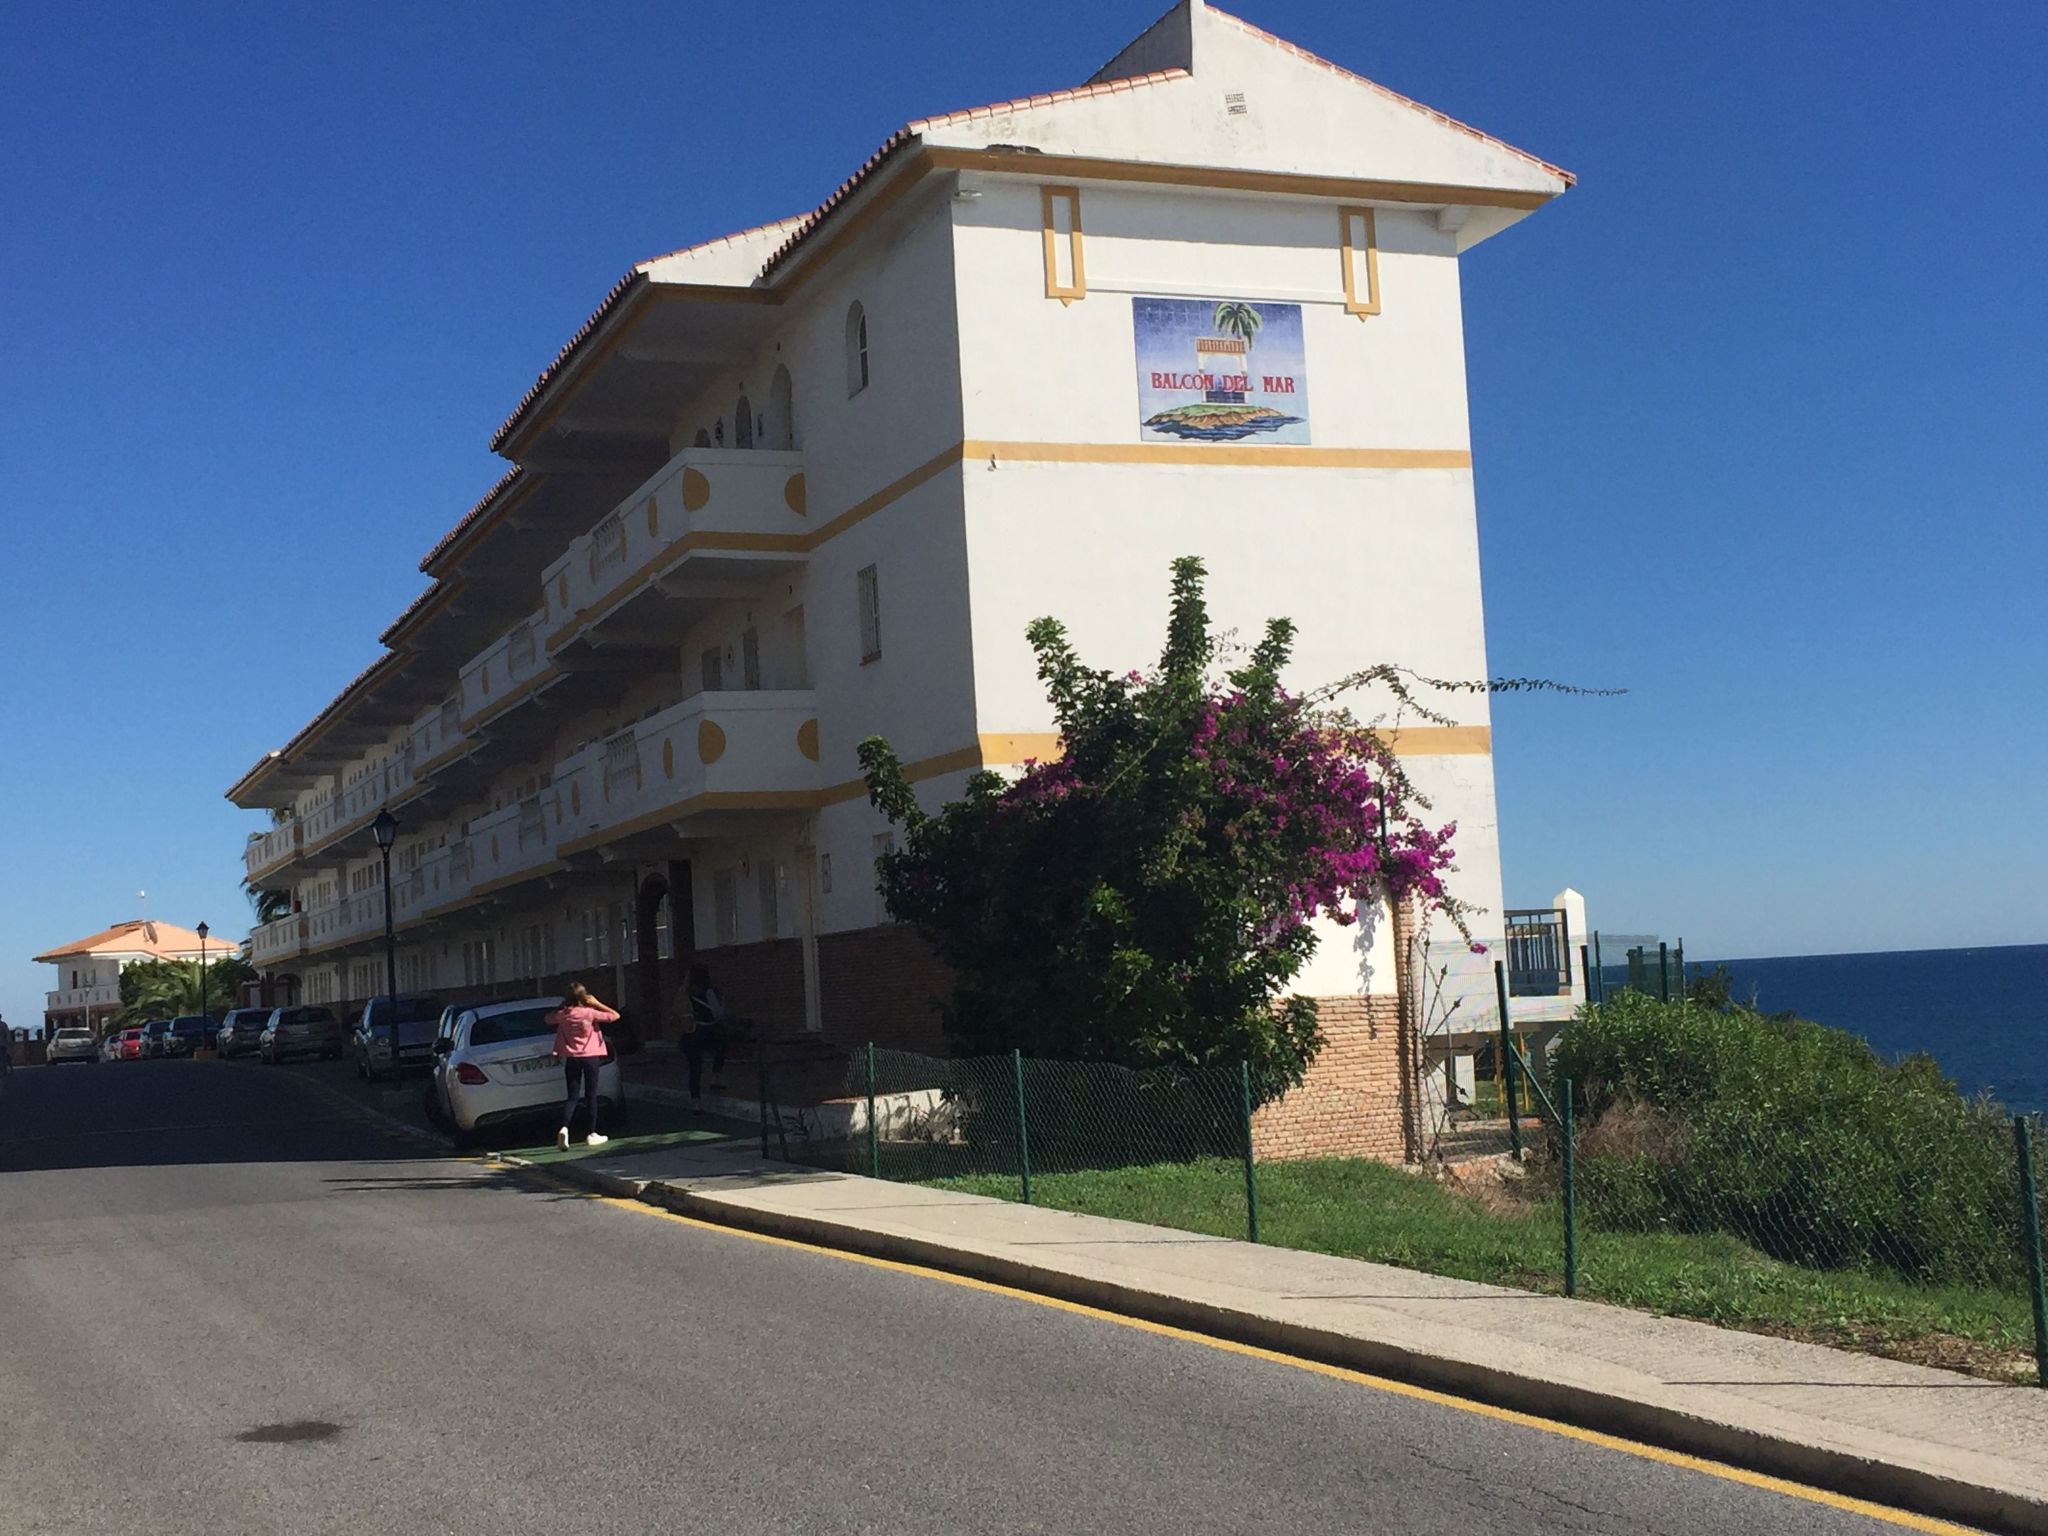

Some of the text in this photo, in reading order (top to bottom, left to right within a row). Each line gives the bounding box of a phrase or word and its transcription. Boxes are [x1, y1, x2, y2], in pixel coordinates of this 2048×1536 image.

[1151, 372, 1295, 393] BALCON DEL MAR
